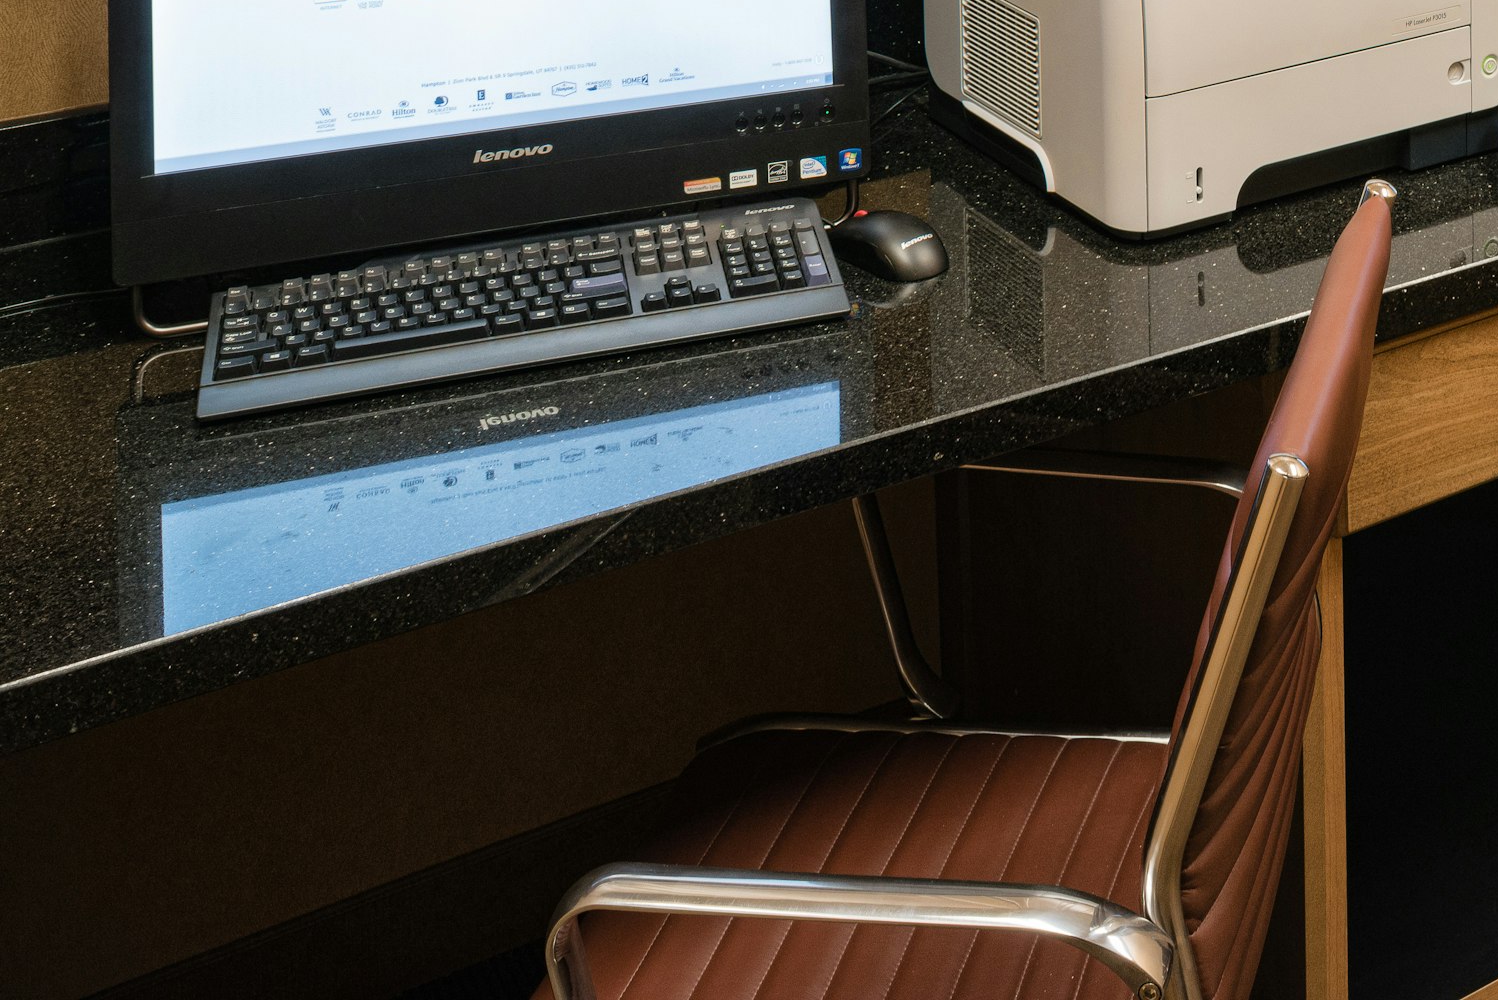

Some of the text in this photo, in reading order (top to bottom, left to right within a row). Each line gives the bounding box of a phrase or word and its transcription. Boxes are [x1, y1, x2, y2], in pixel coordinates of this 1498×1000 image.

[1413, 16, 1432, 26] LaserJet
[347, 109, 382, 119] CONRAD
[391, 108, 416, 117] Hilton
[473, 143, 553, 164] lenovo
[745, 204, 795, 215] lenovo
[901, 234, 933, 250] lenovo
